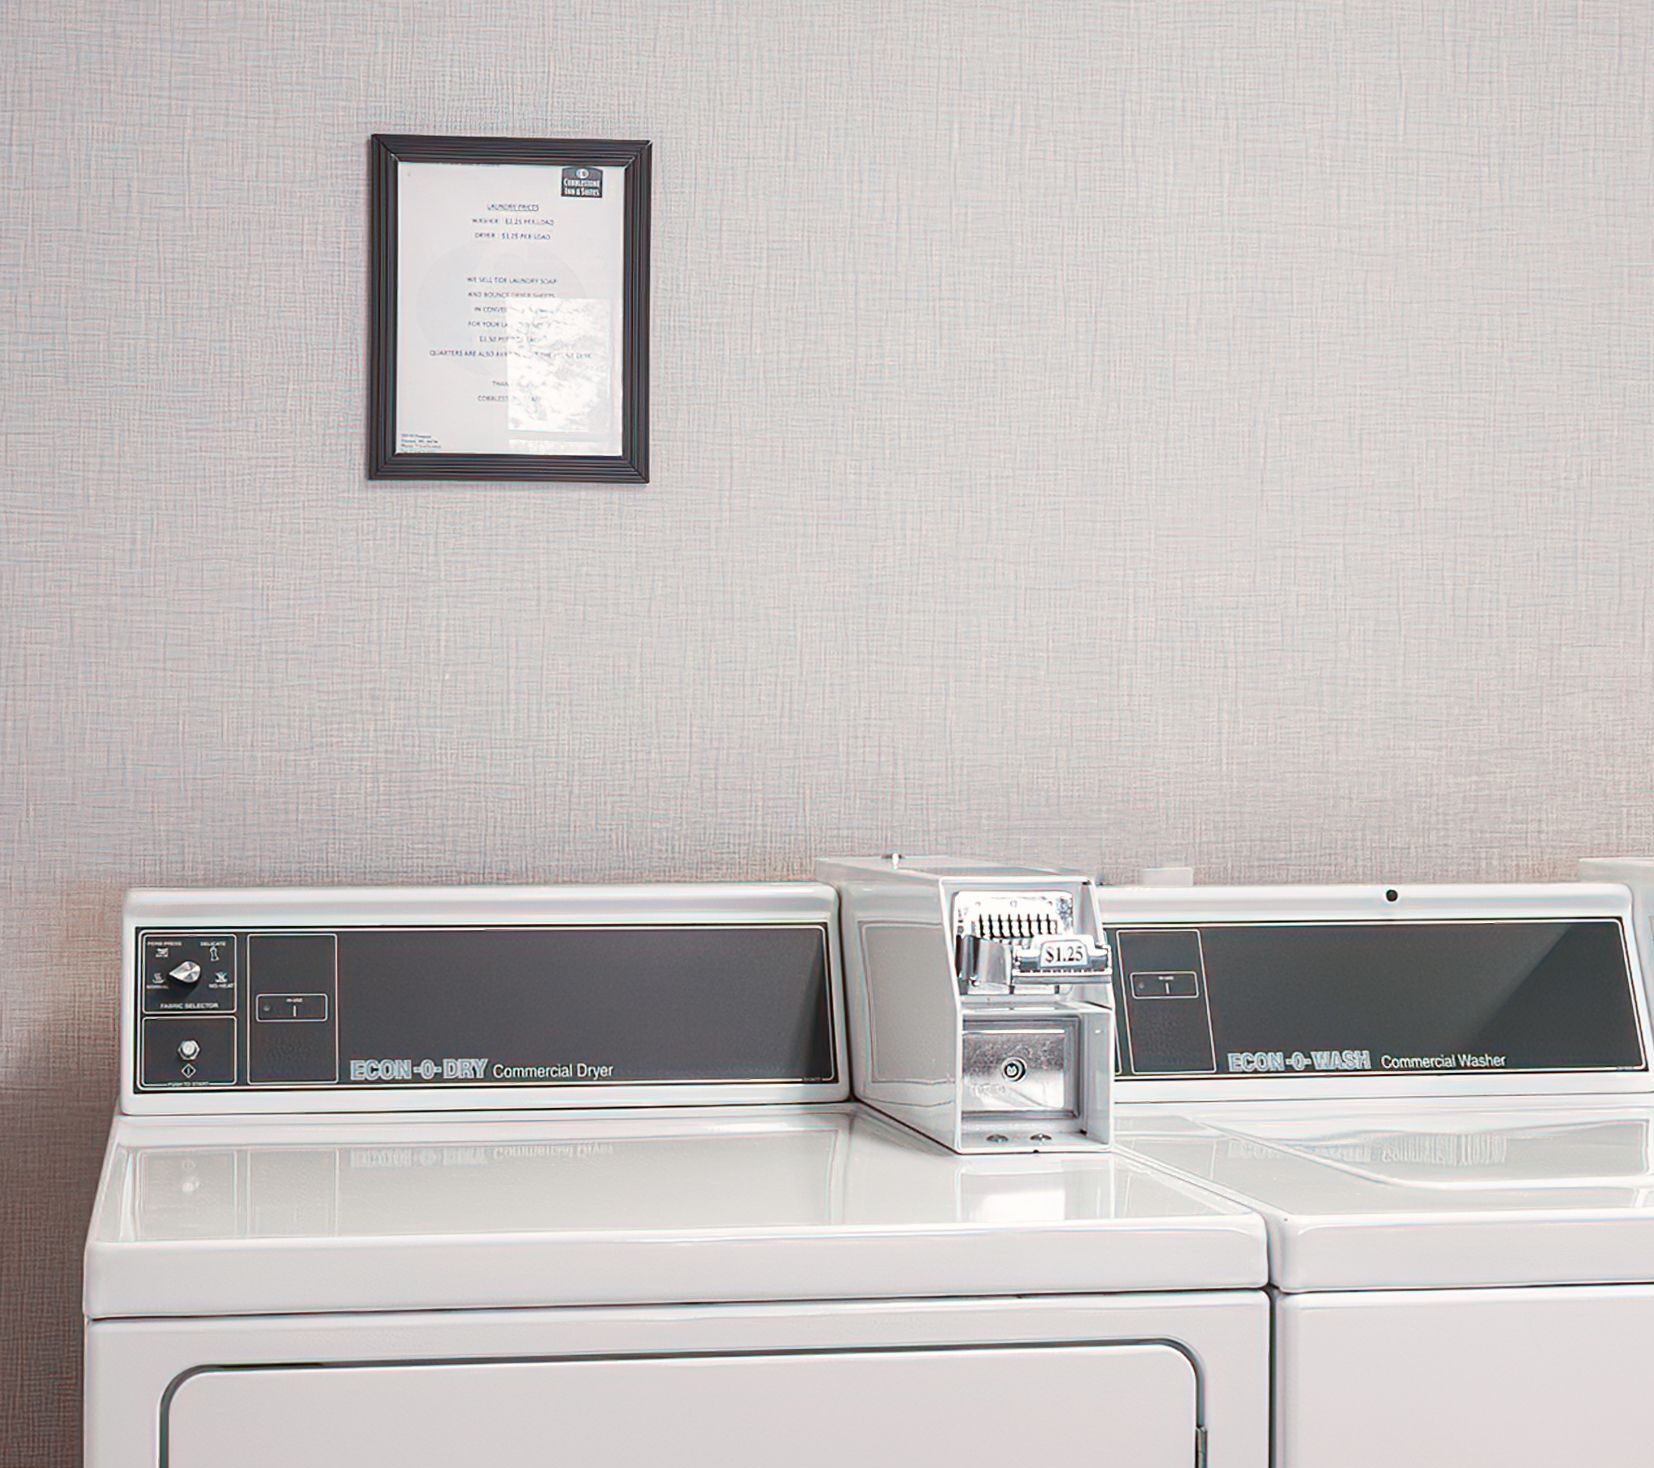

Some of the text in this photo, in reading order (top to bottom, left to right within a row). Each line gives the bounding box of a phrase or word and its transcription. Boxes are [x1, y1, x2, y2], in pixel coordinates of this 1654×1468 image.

[1045, 946, 1083, 963] $1.25
[350, 1058, 614, 1081] ECON-O-DRY Commercial Dryer
[1227, 1050, 1506, 1073] ECON-O-WASH Commercial Washer
